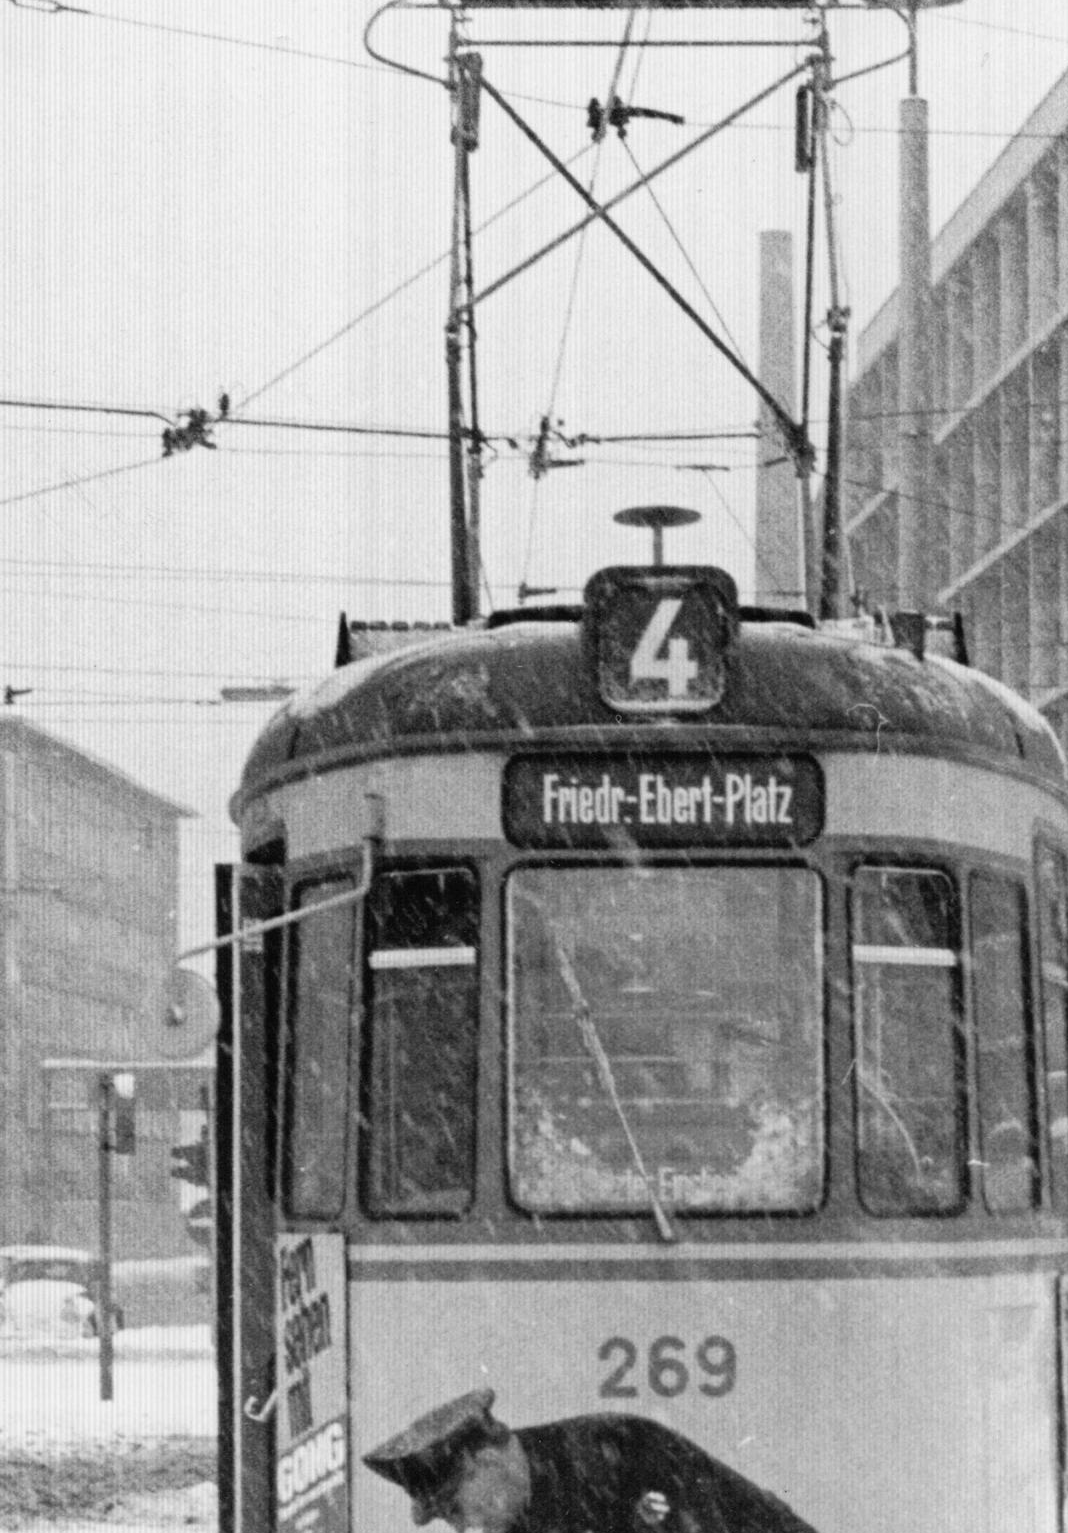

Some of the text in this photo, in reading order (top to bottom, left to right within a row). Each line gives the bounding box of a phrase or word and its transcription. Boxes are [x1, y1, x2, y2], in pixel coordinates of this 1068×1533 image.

[629, 598, 699, 697] 4
[542, 773, 793, 825] Friedr.-Ebert-Platz
[598, 1334, 738, 1399] 269
[277, 1421, 344, 1504] GONG
